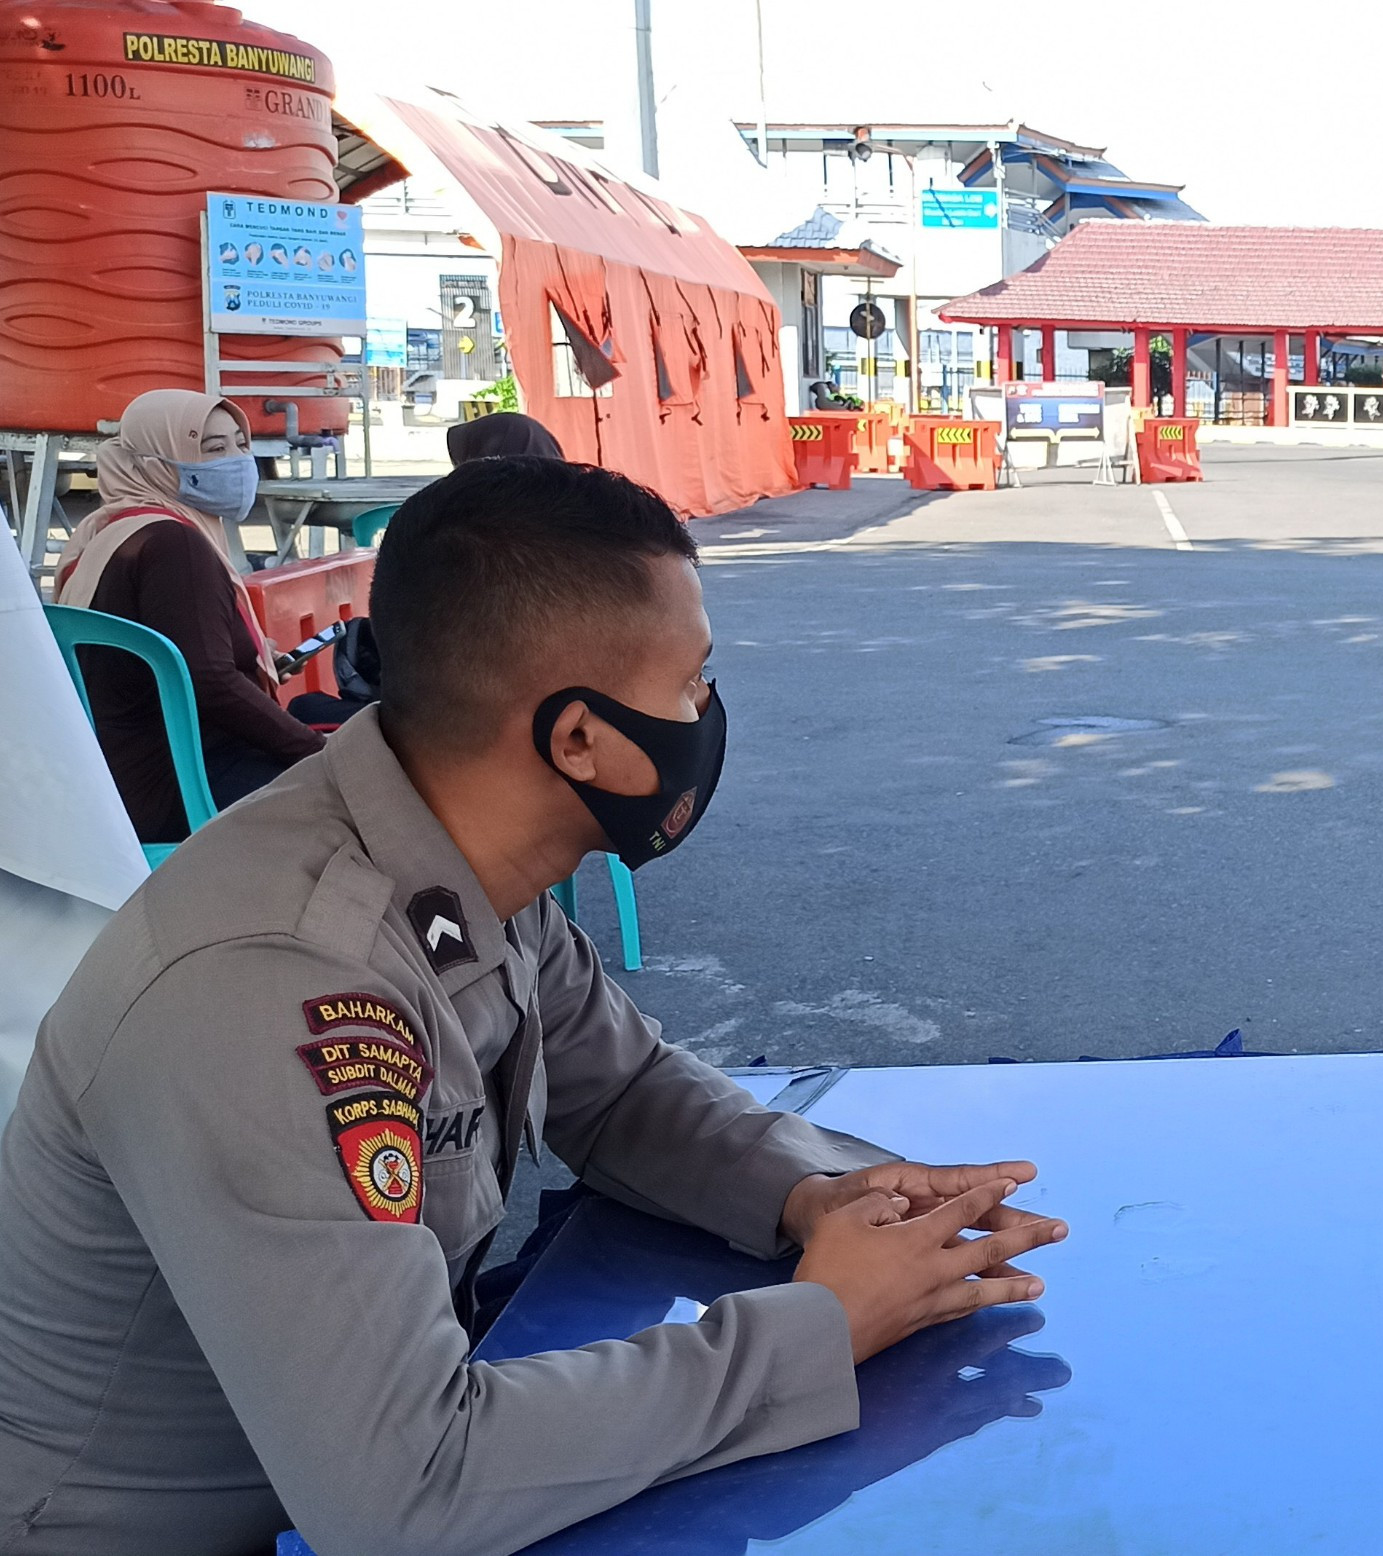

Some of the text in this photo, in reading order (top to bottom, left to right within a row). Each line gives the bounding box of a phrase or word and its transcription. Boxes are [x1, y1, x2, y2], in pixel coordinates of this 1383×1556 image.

[126, 35, 315, 82] POLRESTA BANYUWANGI
[264, 89, 324, 122] GRAND
[246, 202, 328, 218] TEDMOND
[247, 290, 357, 303] POLRESTA BANYUWANGI
[247, 299, 281, 309] PEDULI
[284, 301, 313, 310] COVID
[453, 296, 476, 328] 2
[649, 830, 666, 852] TNI
[319, 1001, 414, 1045] BAHARKAM
[321, 1043, 423, 1083] DIT SAMAPTA
[328, 1064, 417, 1099] SUBDIT DALMAS
[334, 1100, 377, 1125] KORPS
